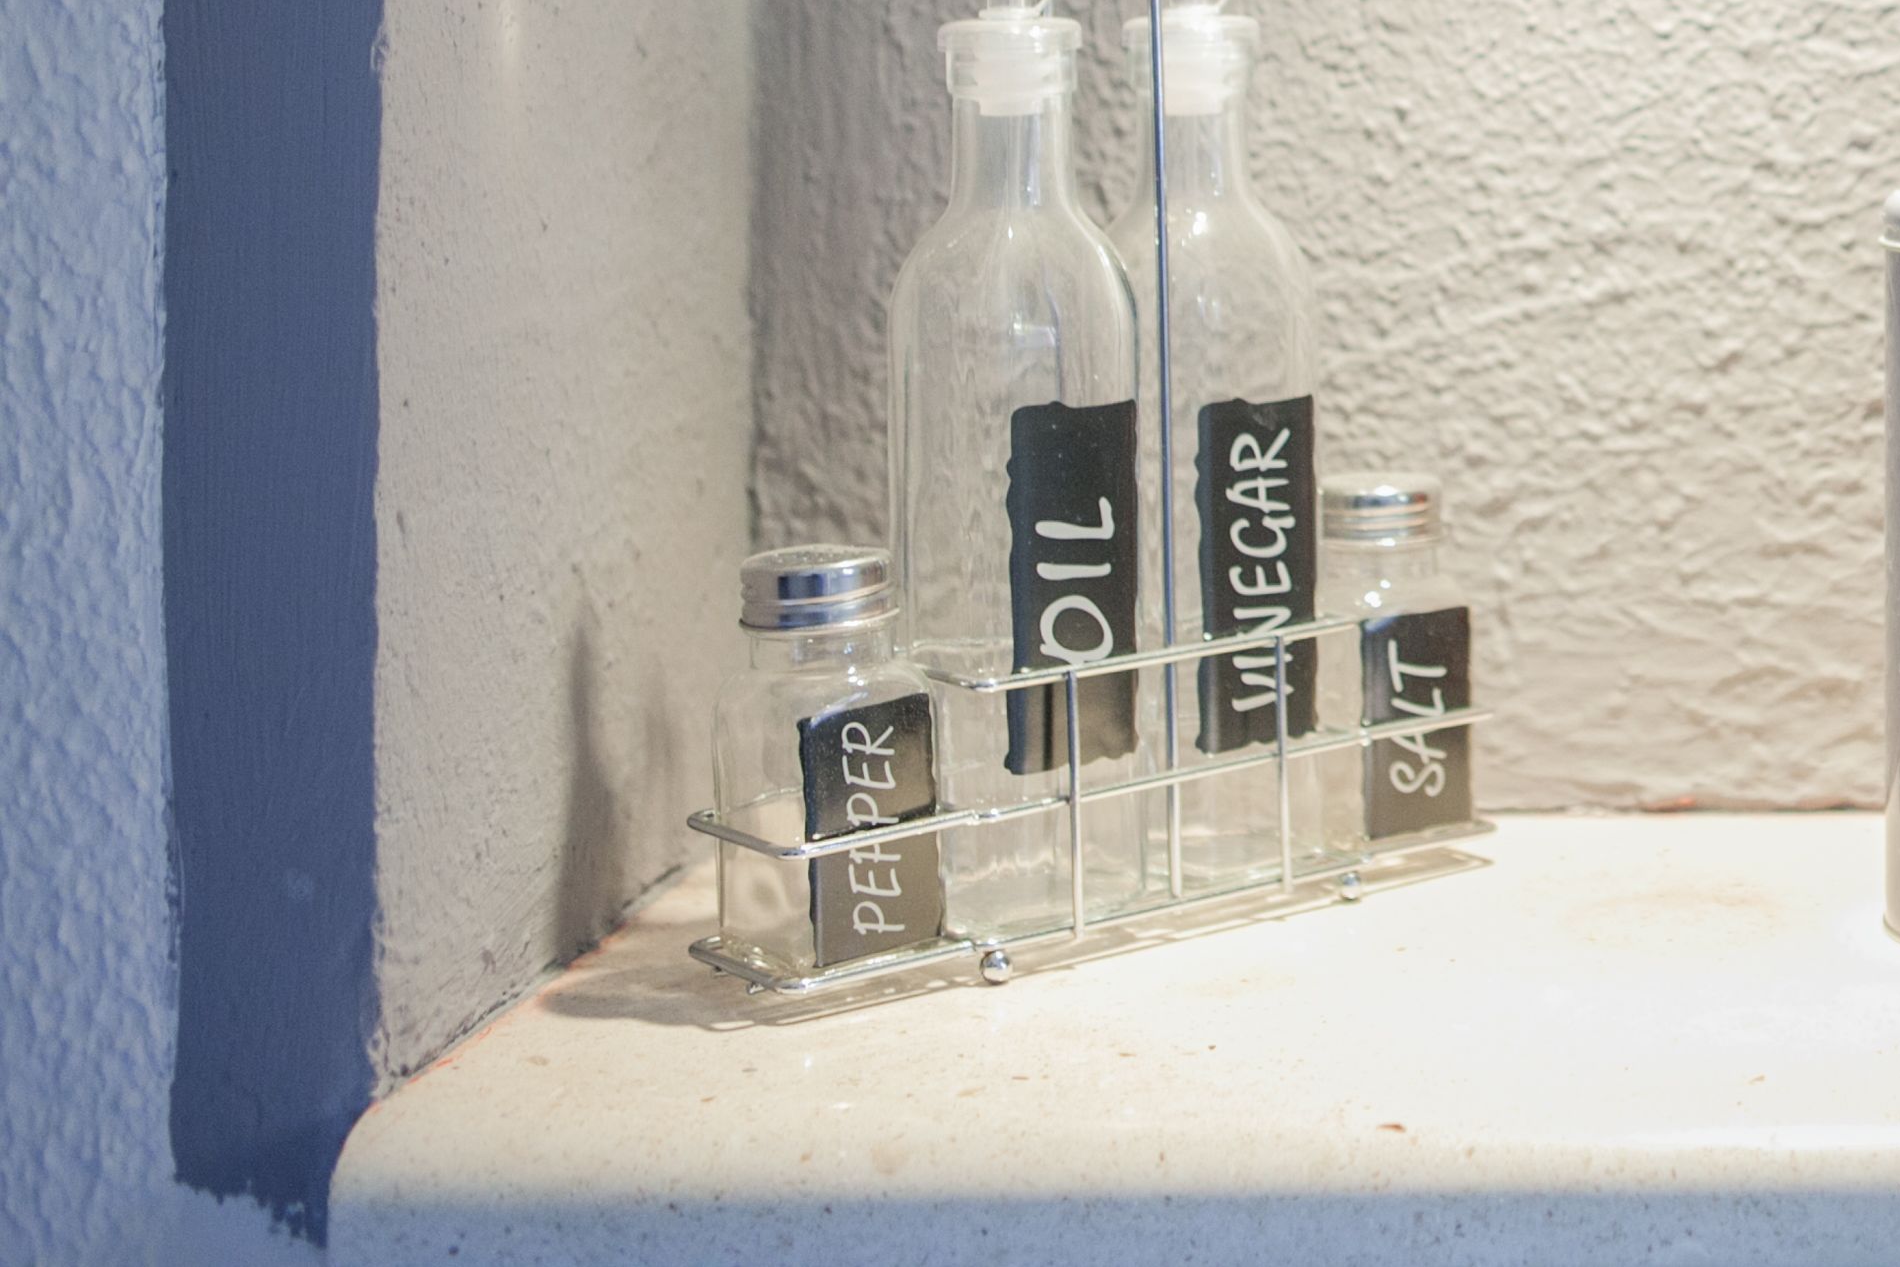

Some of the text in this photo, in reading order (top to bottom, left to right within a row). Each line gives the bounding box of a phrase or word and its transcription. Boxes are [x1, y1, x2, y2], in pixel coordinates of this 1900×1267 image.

[1035, 496, 1115, 665] OIL
[1388, 639, 1447, 797] SALT
[841, 721, 905, 935] PEPPER
